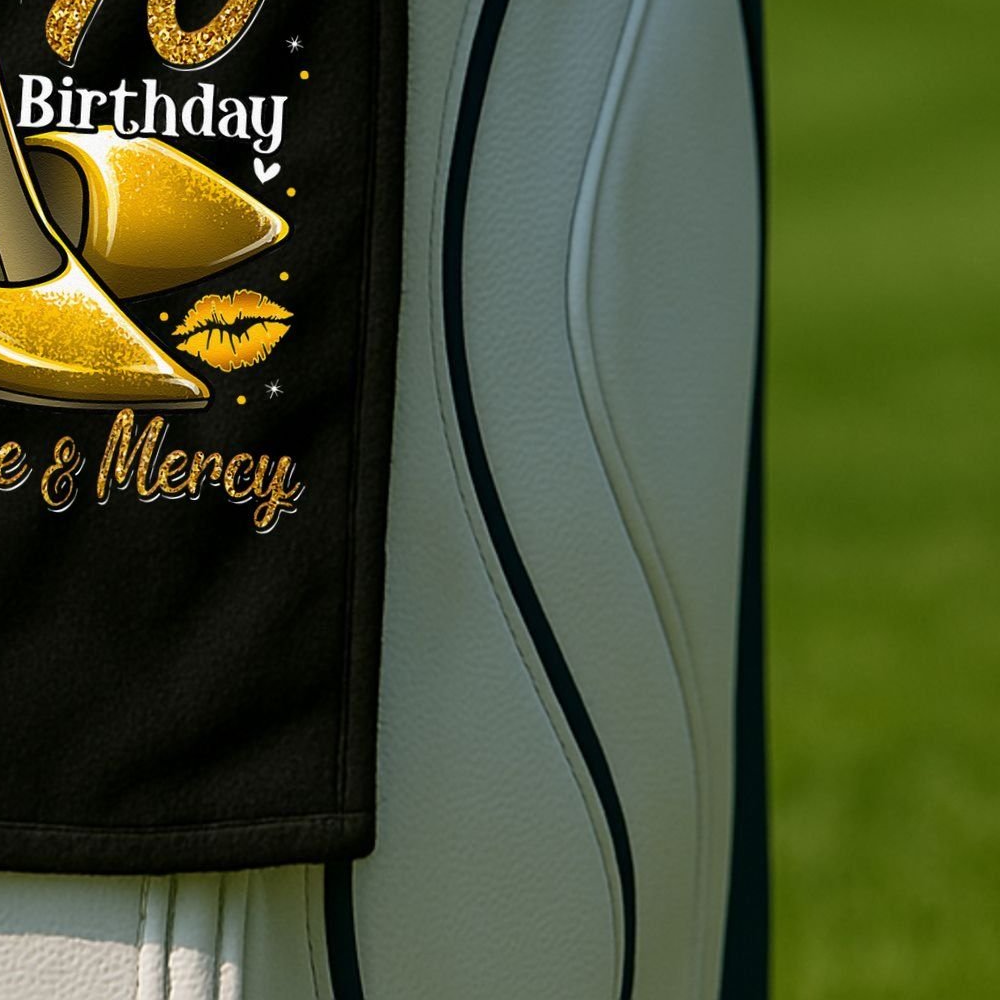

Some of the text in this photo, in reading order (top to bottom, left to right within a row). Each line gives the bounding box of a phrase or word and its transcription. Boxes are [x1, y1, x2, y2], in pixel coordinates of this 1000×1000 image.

[16, 74, 288, 152] Birthday
[39, 435, 83, 512] &
[96, 407, 306, 534] Mercy
